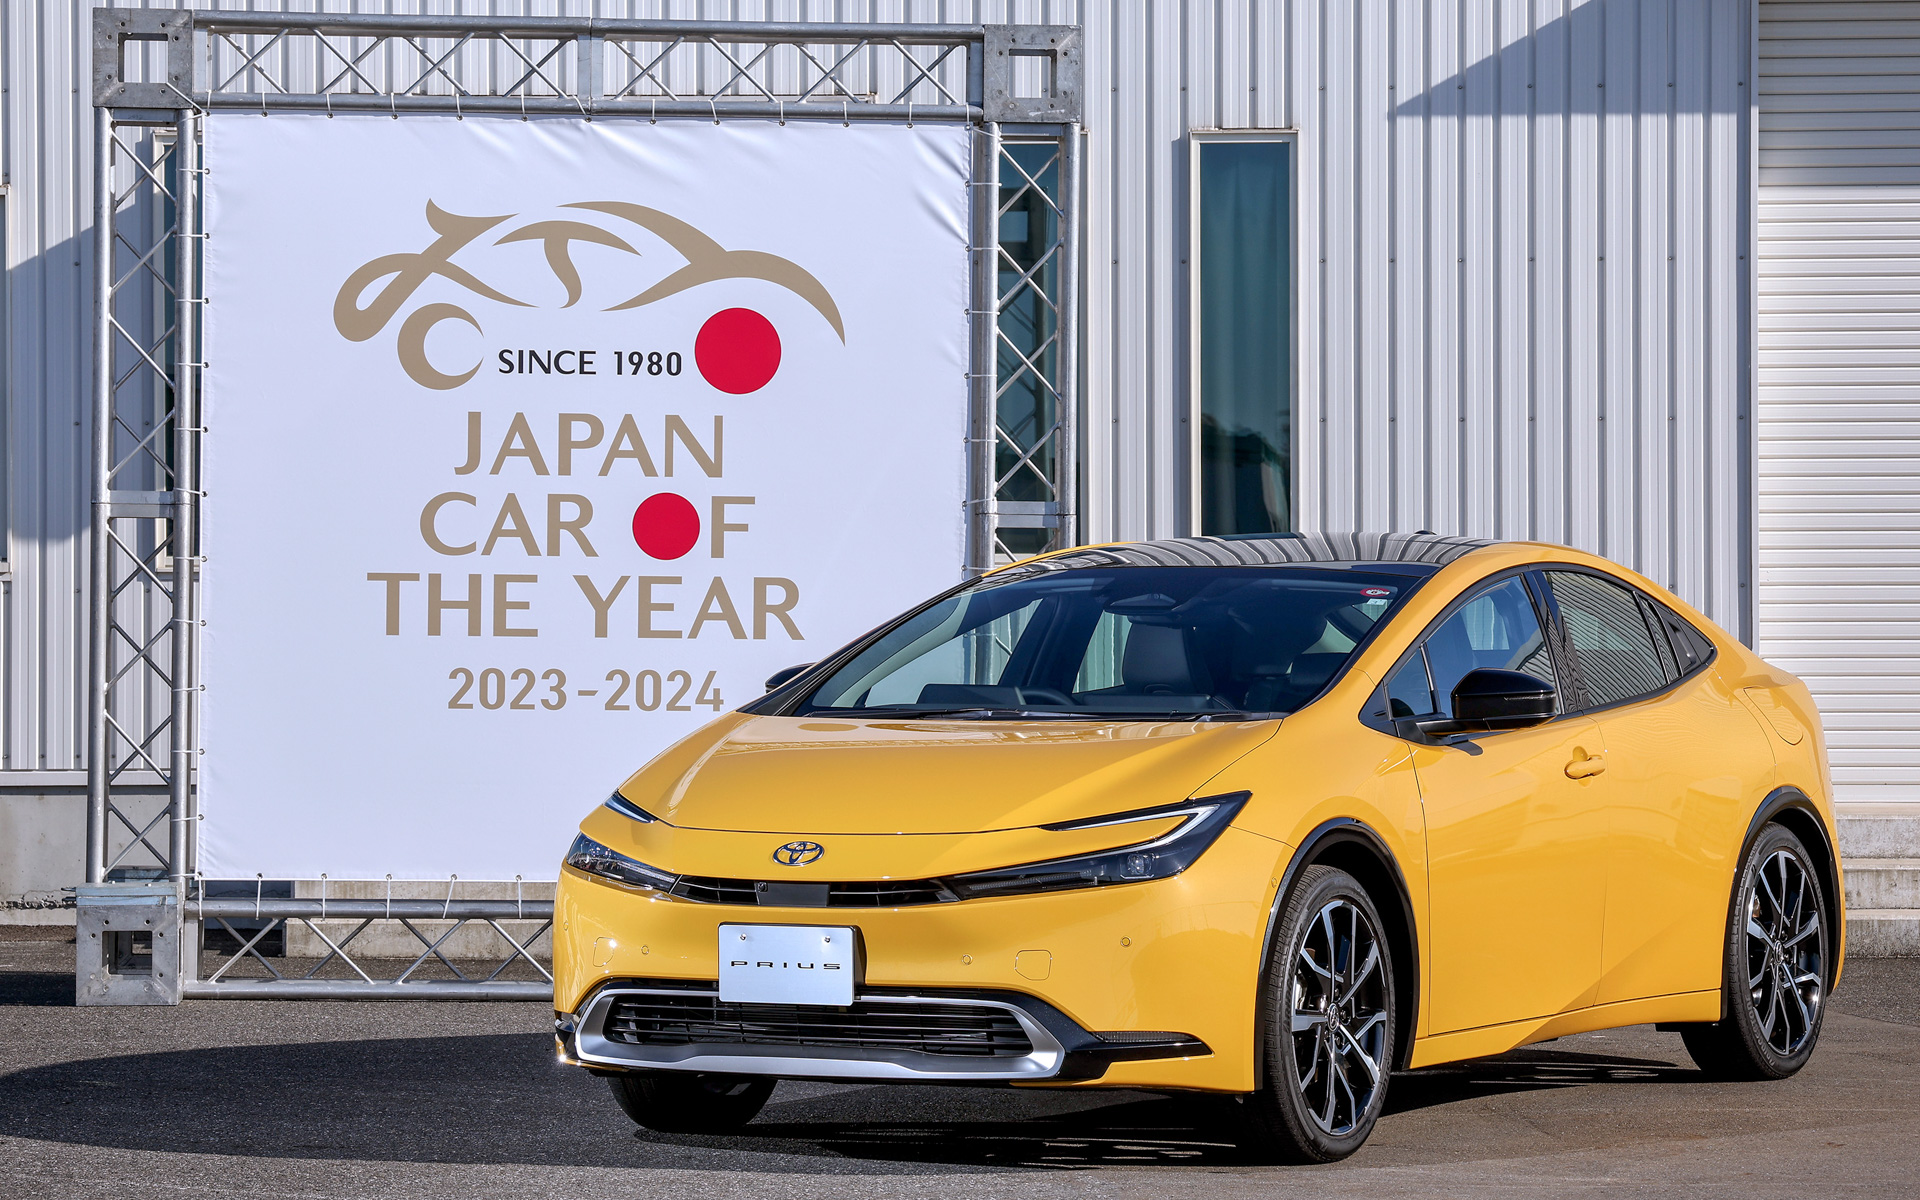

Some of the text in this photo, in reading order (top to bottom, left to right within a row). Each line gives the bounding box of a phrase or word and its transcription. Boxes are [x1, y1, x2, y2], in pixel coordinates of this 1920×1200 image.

[498, 349, 682, 376] SINCE 1980
[454, 411, 724, 478] JAPAN
[419, 491, 600, 558] CAR
[366, 572, 806, 641] THE YEAR
[730, 960, 841, 970] PRIUS
